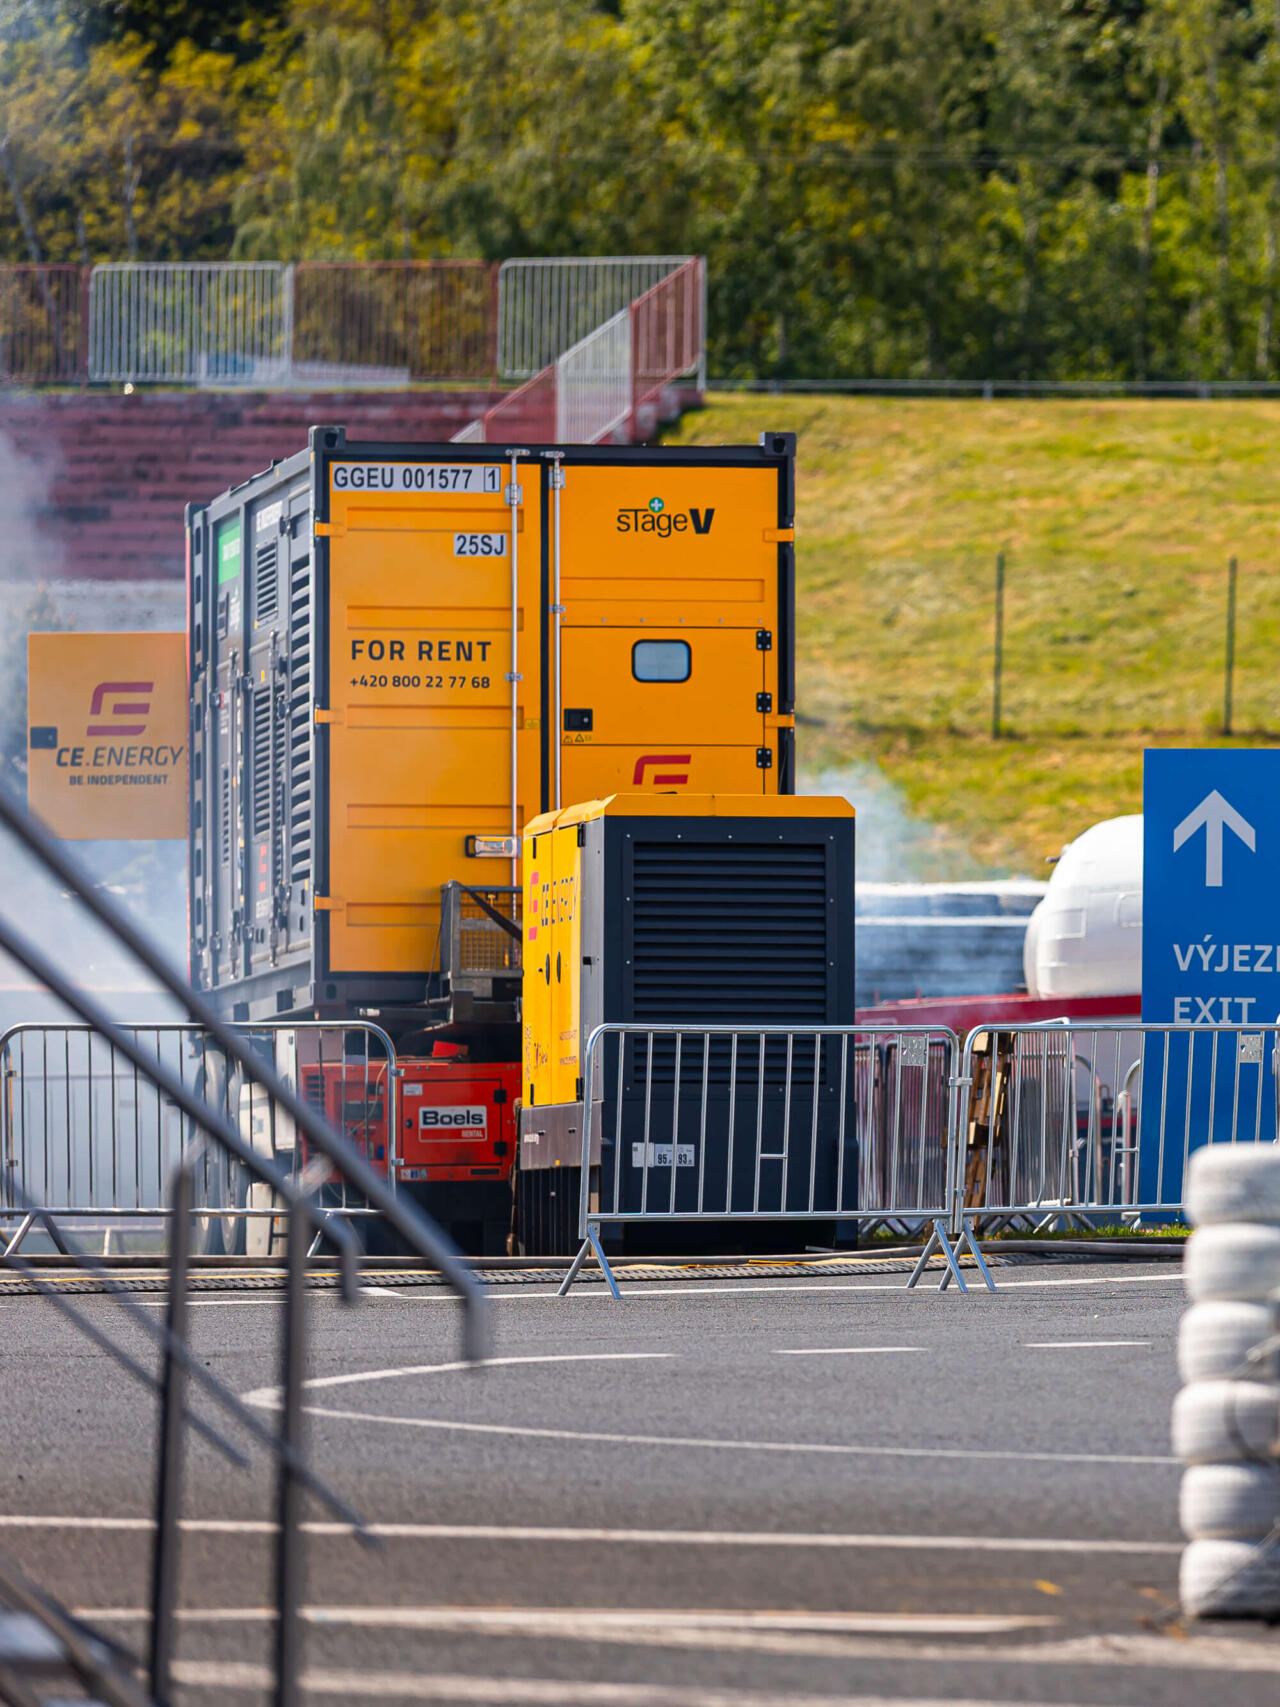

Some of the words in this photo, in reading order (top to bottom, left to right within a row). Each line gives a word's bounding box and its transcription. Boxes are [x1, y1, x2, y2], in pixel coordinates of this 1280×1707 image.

[334, 466, 394, 488] GGEU
[402, 468, 473, 489] 001577
[487, 469, 497, 490] 1
[456, 534, 505, 556] 25SJ
[351, 639, 406, 661] FOR
[417, 640, 492, 662] RENT
[350, 675, 388, 688] +420
[392, 675, 421, 688] 800
[425, 675, 443, 689] 22
[448, 676, 467, 689] 77
[471, 676, 491, 689] 68
[56, 746, 184, 767] CE.ENERGY
[69, 774, 84, 786] BE
[87, 774, 168, 786] INDEPENDENT
[1174, 997, 1256, 1023] EXIT
[422, 1110, 484, 1126] Boels
[657, 1154, 667, 1165] 95
[678, 1154, 687, 1165] 93
